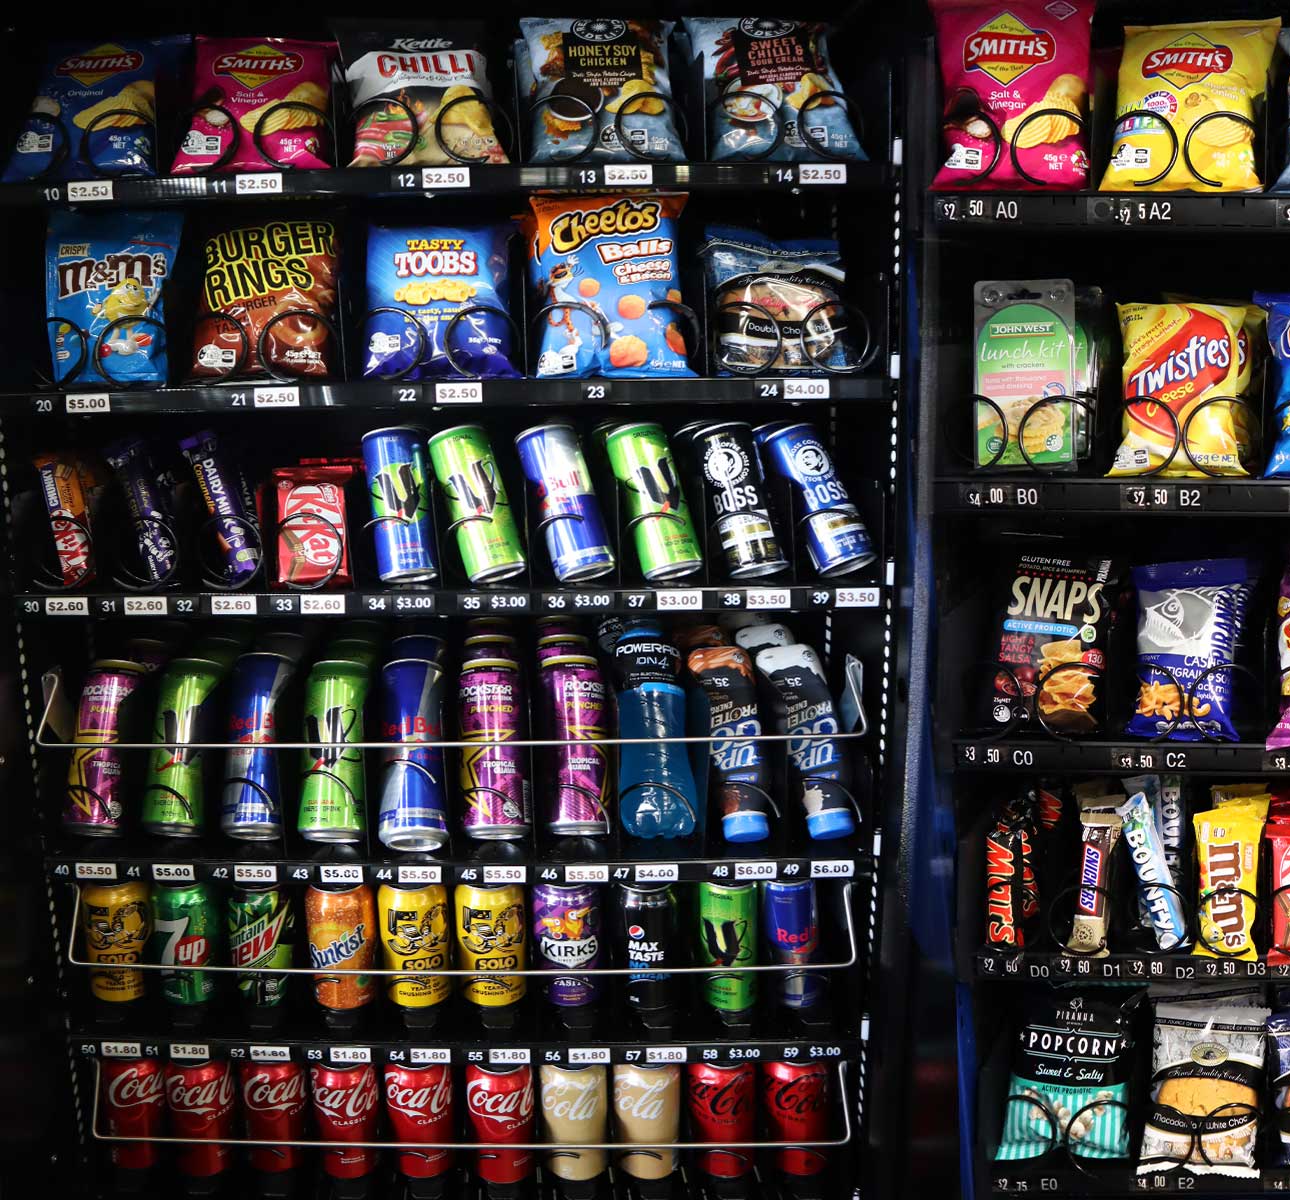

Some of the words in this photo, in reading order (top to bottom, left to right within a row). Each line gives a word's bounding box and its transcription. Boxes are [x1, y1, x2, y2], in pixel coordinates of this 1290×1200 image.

[393, 38, 452, 51] Kettle
[568, 44, 611, 58] HONEY
[614, 45, 636, 56] SOY
[968, 37, 1051, 61] SMITH'S
[63, 56, 135, 71] SMITH'S
[219, 56, 296, 71] SMITH'S
[377, 53, 475, 76] CHILLI
[580, 57, 627, 66] CHICKEN
[1145, 50, 1227, 70] SMITH'S
[68, 89, 103, 97] Original
[990, 90, 1010, 99] Salt
[1013, 91, 1020, 99] &
[988, 100, 1027, 110] Vinegar
[1043, 154, 1059, 162] 45g
[776, 170, 793, 181] 14
[802, 168, 841, 180] $2.50
[43, 188, 59, 200] 10
[71, 185, 108, 197] $2.50
[551, 201, 661, 254] Cheetos
[60, 245, 87, 256] CRISPY
[204, 222, 335, 267] BURGER
[407, 239, 464, 251] TASTY
[597, 239, 673, 263] Balls
[394, 250, 478, 277] TOOBS
[614, 260, 671, 276] Cheese
[205, 259, 313, 310] RINGS
[993, 326, 1019, 335] JOHN
[1022, 324, 1052, 334] WEST
[979, 340, 1033, 362] lunch
[1039, 340, 1064, 360] kit
[1002, 361, 1016, 369] with
[1018, 360, 1044, 368] crackers
[1130, 335, 1229, 397] Twisties
[761, 385, 777, 396] 24
[787, 382, 825, 395] $4.00
[36, 400, 52, 411] 20
[69, 398, 105, 409] $5.00
[714, 486, 758, 514] BOSS
[1180, 489, 1200, 506] B2
[1021, 555, 1047, 565] GLUTEN
[1050, 558, 1071, 567] FREE
[24, 600, 39, 612] 30
[49, 600, 84, 612] $2.60
[548, 596, 565, 608] 36
[575, 594, 610, 608] $3.00
[1006, 576, 1102, 623] SNAPS
[1006, 621, 1032, 630] ACTIVE
[1033, 625, 1075, 634] PROBIOTIC
[1000, 643, 1033, 654] TANGY
[998, 653, 1031, 663] SALSA
[459, 684, 513, 697] ROCKSTAR
[470, 704, 513, 715] PUNCHED
[483, 760, 515, 769] TROPICAL
[54, 865, 69, 877] 40
[78, 865, 112, 876] $5.50
[461, 868, 477, 879] 45
[486, 869, 521, 880] $5.50
[1079, 846, 1099, 911] SNICKERS
[1126, 829, 1174, 939] BOUNTY
[310, 923, 366, 969] Sunkist
[543, 942, 597, 956] KIRKS
[628, 941, 658, 952] MAX
[628, 950, 664, 962] TASTE
[476, 956, 518, 970] SOLO
[1247, 963, 1265, 976] D3
[1029, 1031, 1116, 1056] POPCORN
[308, 1050, 323, 1060] 53
[333, 1051, 366, 1060] $1.80
[703, 1049, 718, 1059] 58
[728, 1048, 760, 1059] $3.00
[1035, 1064, 1061, 1077] Sweet
[1075, 1068, 1105, 1082] Salty
[1179, 1178, 1194, 1190] E2
